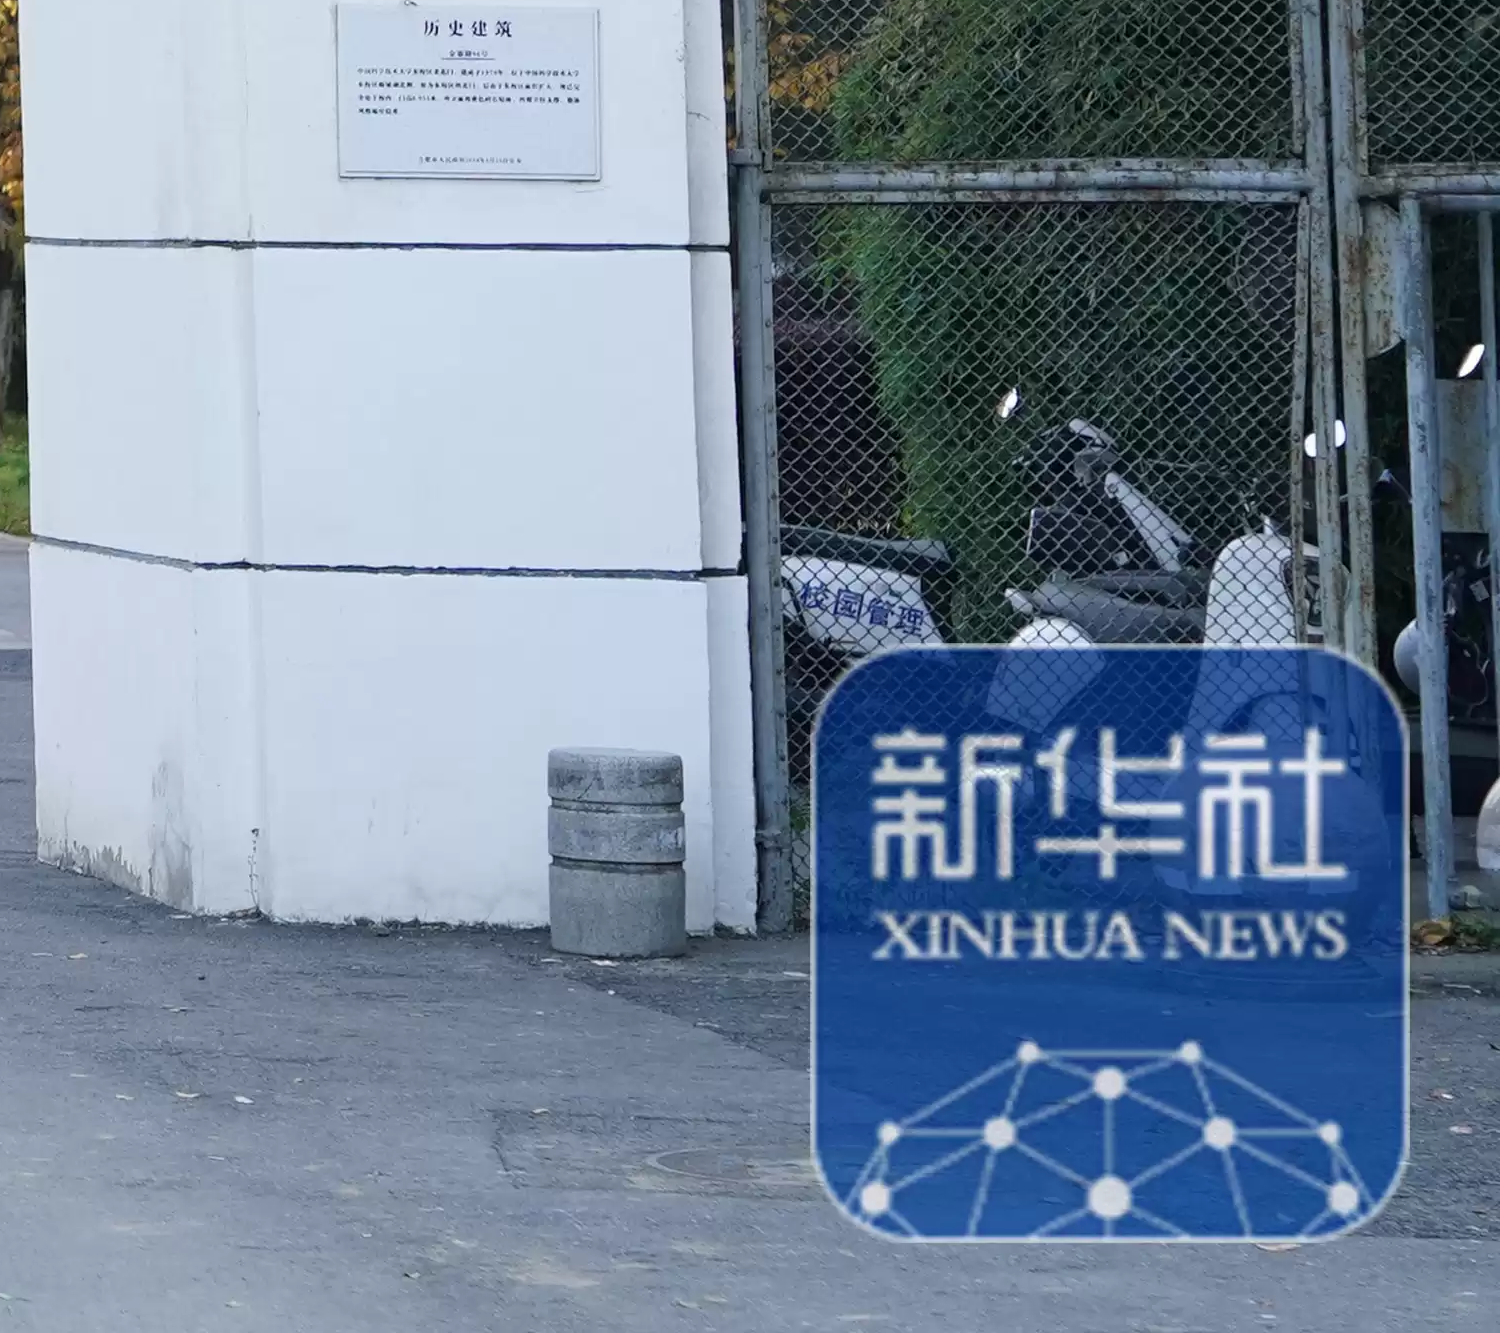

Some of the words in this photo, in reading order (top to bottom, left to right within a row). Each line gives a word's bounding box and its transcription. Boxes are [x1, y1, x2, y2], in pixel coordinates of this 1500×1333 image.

[423, 19, 513, 38] 历史建筑
[800, 581, 924, 638] 校园管理
